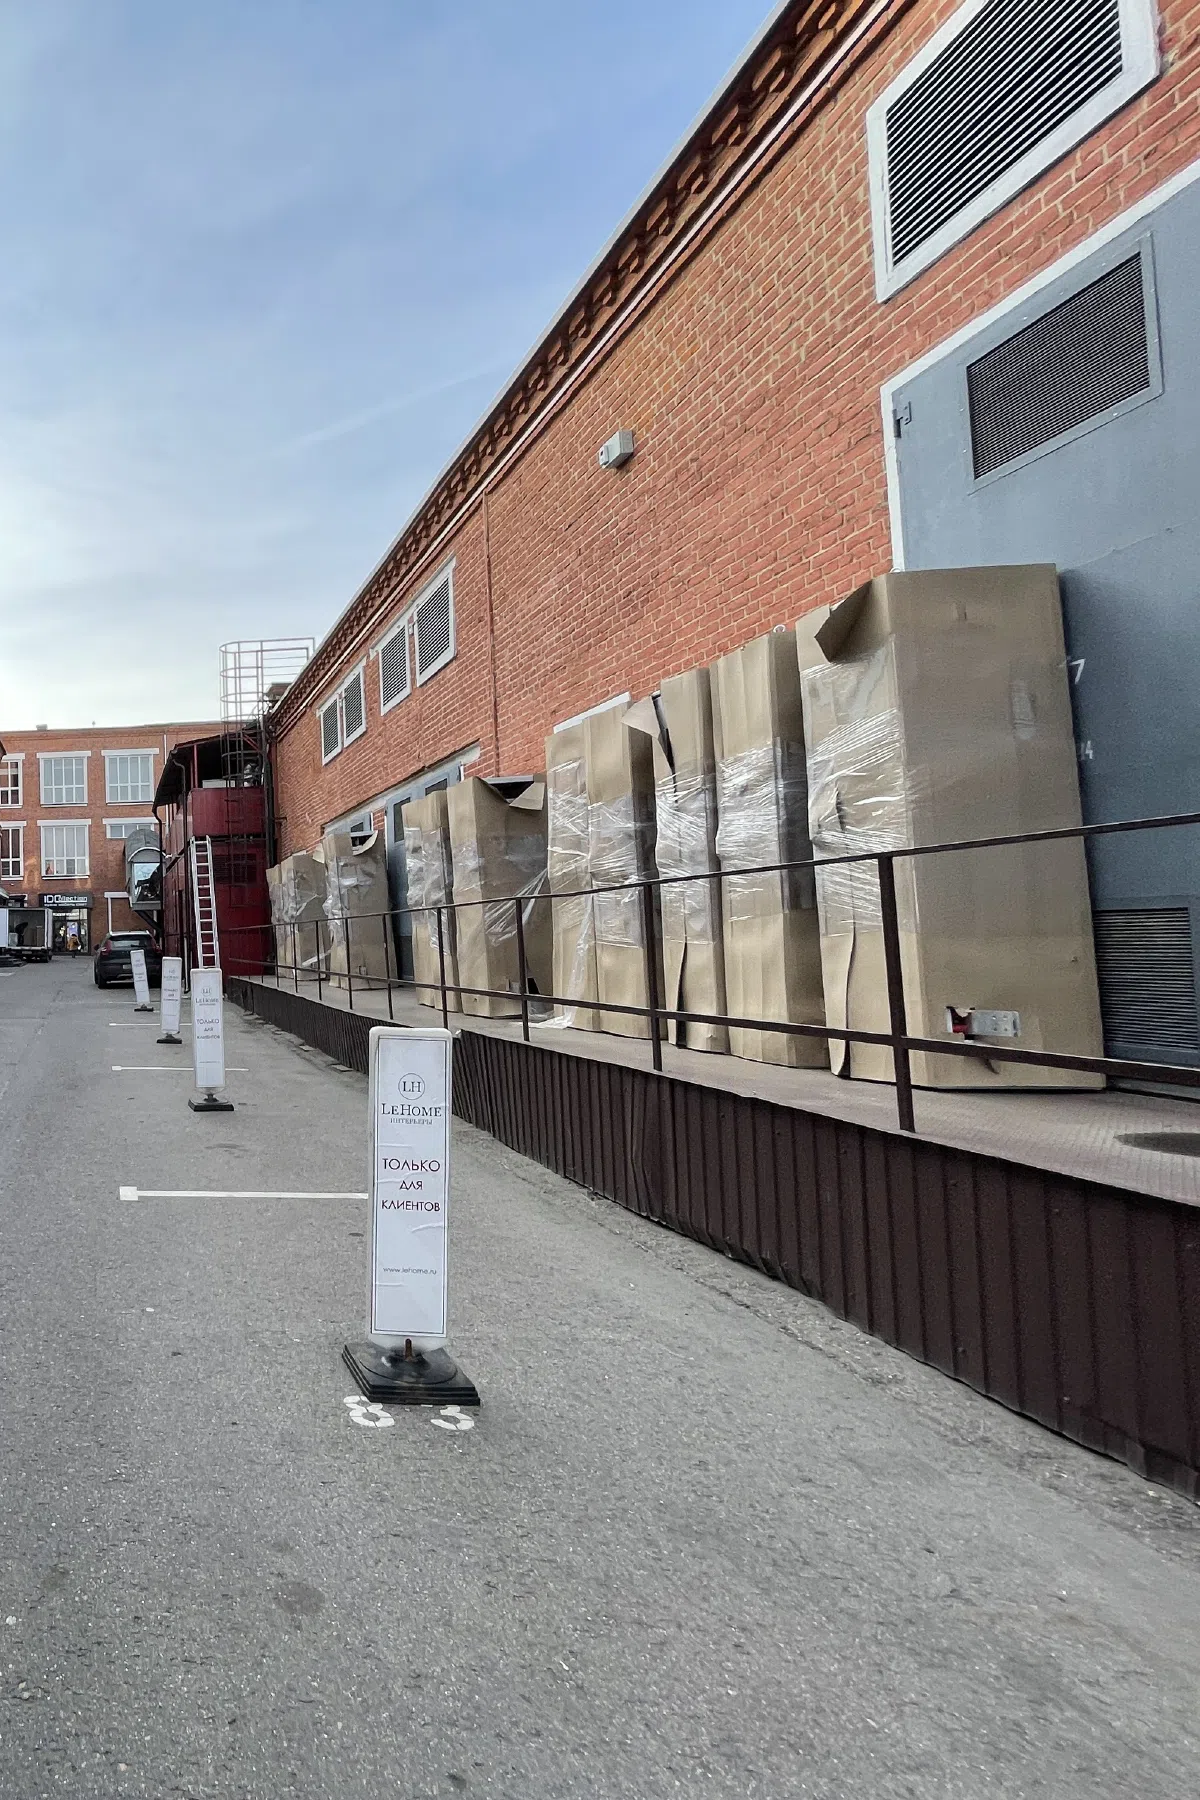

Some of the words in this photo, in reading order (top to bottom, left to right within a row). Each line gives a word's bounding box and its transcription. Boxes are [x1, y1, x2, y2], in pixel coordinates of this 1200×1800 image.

[402, 1080, 422, 1093] LH
[382, 1157, 441, 1173] ТОЛЬКО
[399, 1180, 423, 1191] ДЛЯ
[381, 1200, 441, 1212] КЛИЕНТОВ
